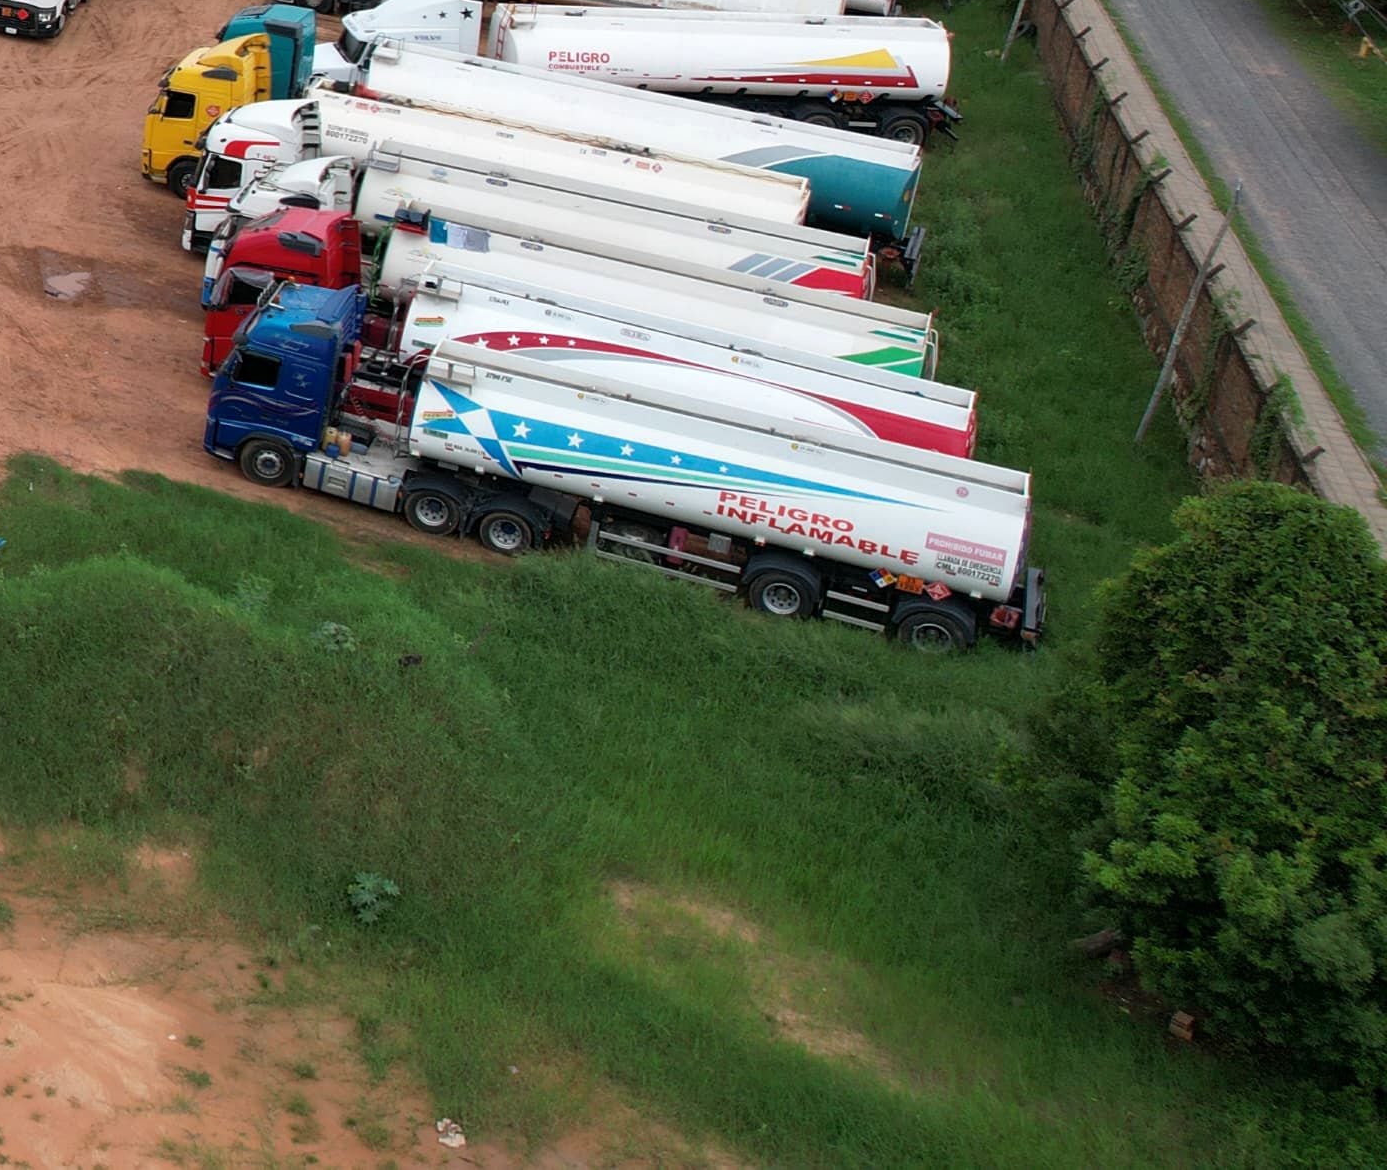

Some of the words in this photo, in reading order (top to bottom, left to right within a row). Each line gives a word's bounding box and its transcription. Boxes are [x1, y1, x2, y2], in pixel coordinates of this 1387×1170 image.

[548, 51, 611, 64] PELIGRO
[548, 63, 601, 72] COMBUSTIBLE
[718, 491, 854, 532] PELIGRO
[717, 504, 919, 565] INFLAMABLE
